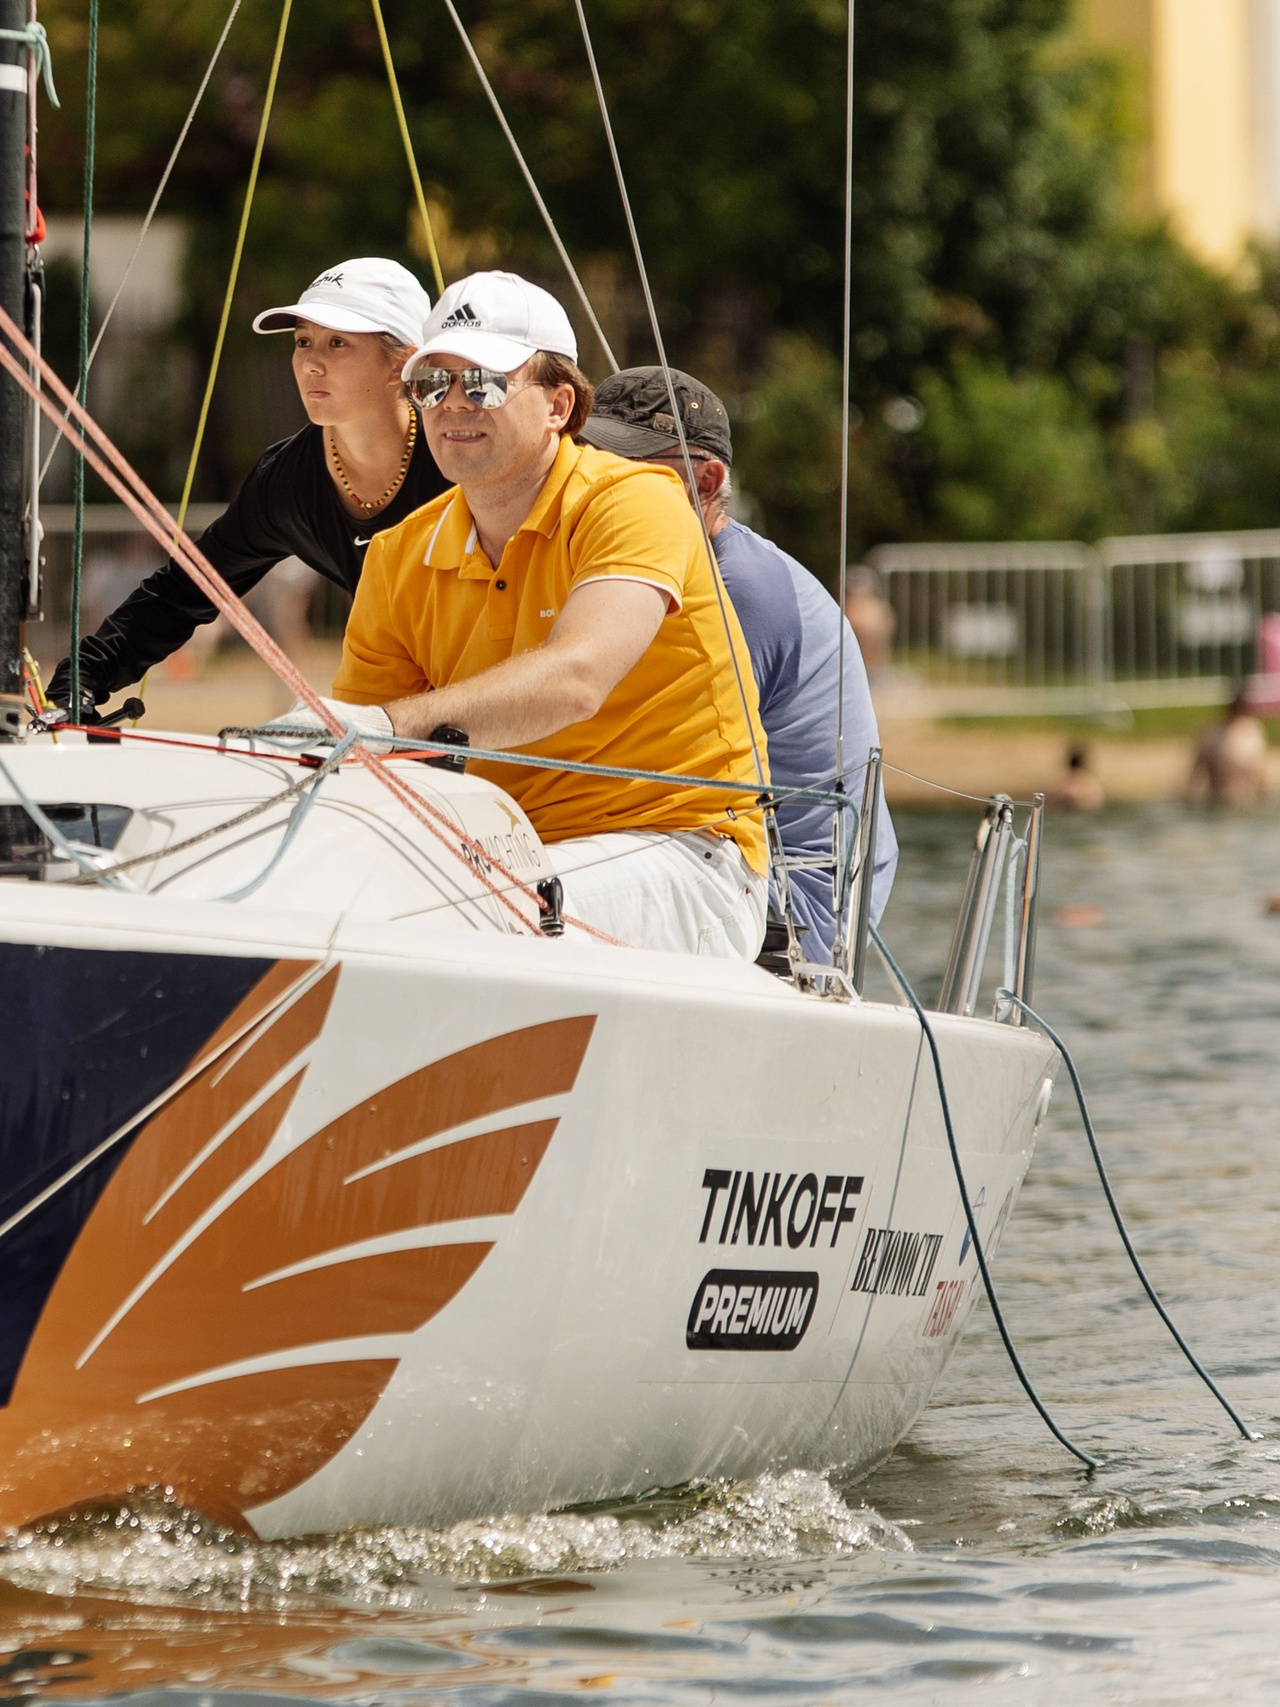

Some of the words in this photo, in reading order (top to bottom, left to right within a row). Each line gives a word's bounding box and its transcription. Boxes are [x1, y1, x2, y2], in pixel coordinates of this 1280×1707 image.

[441, 319, 482, 329] adidas
[698, 1168, 865, 1249] TINKOFF
[693, 1284, 815, 1336] PREMIUM
